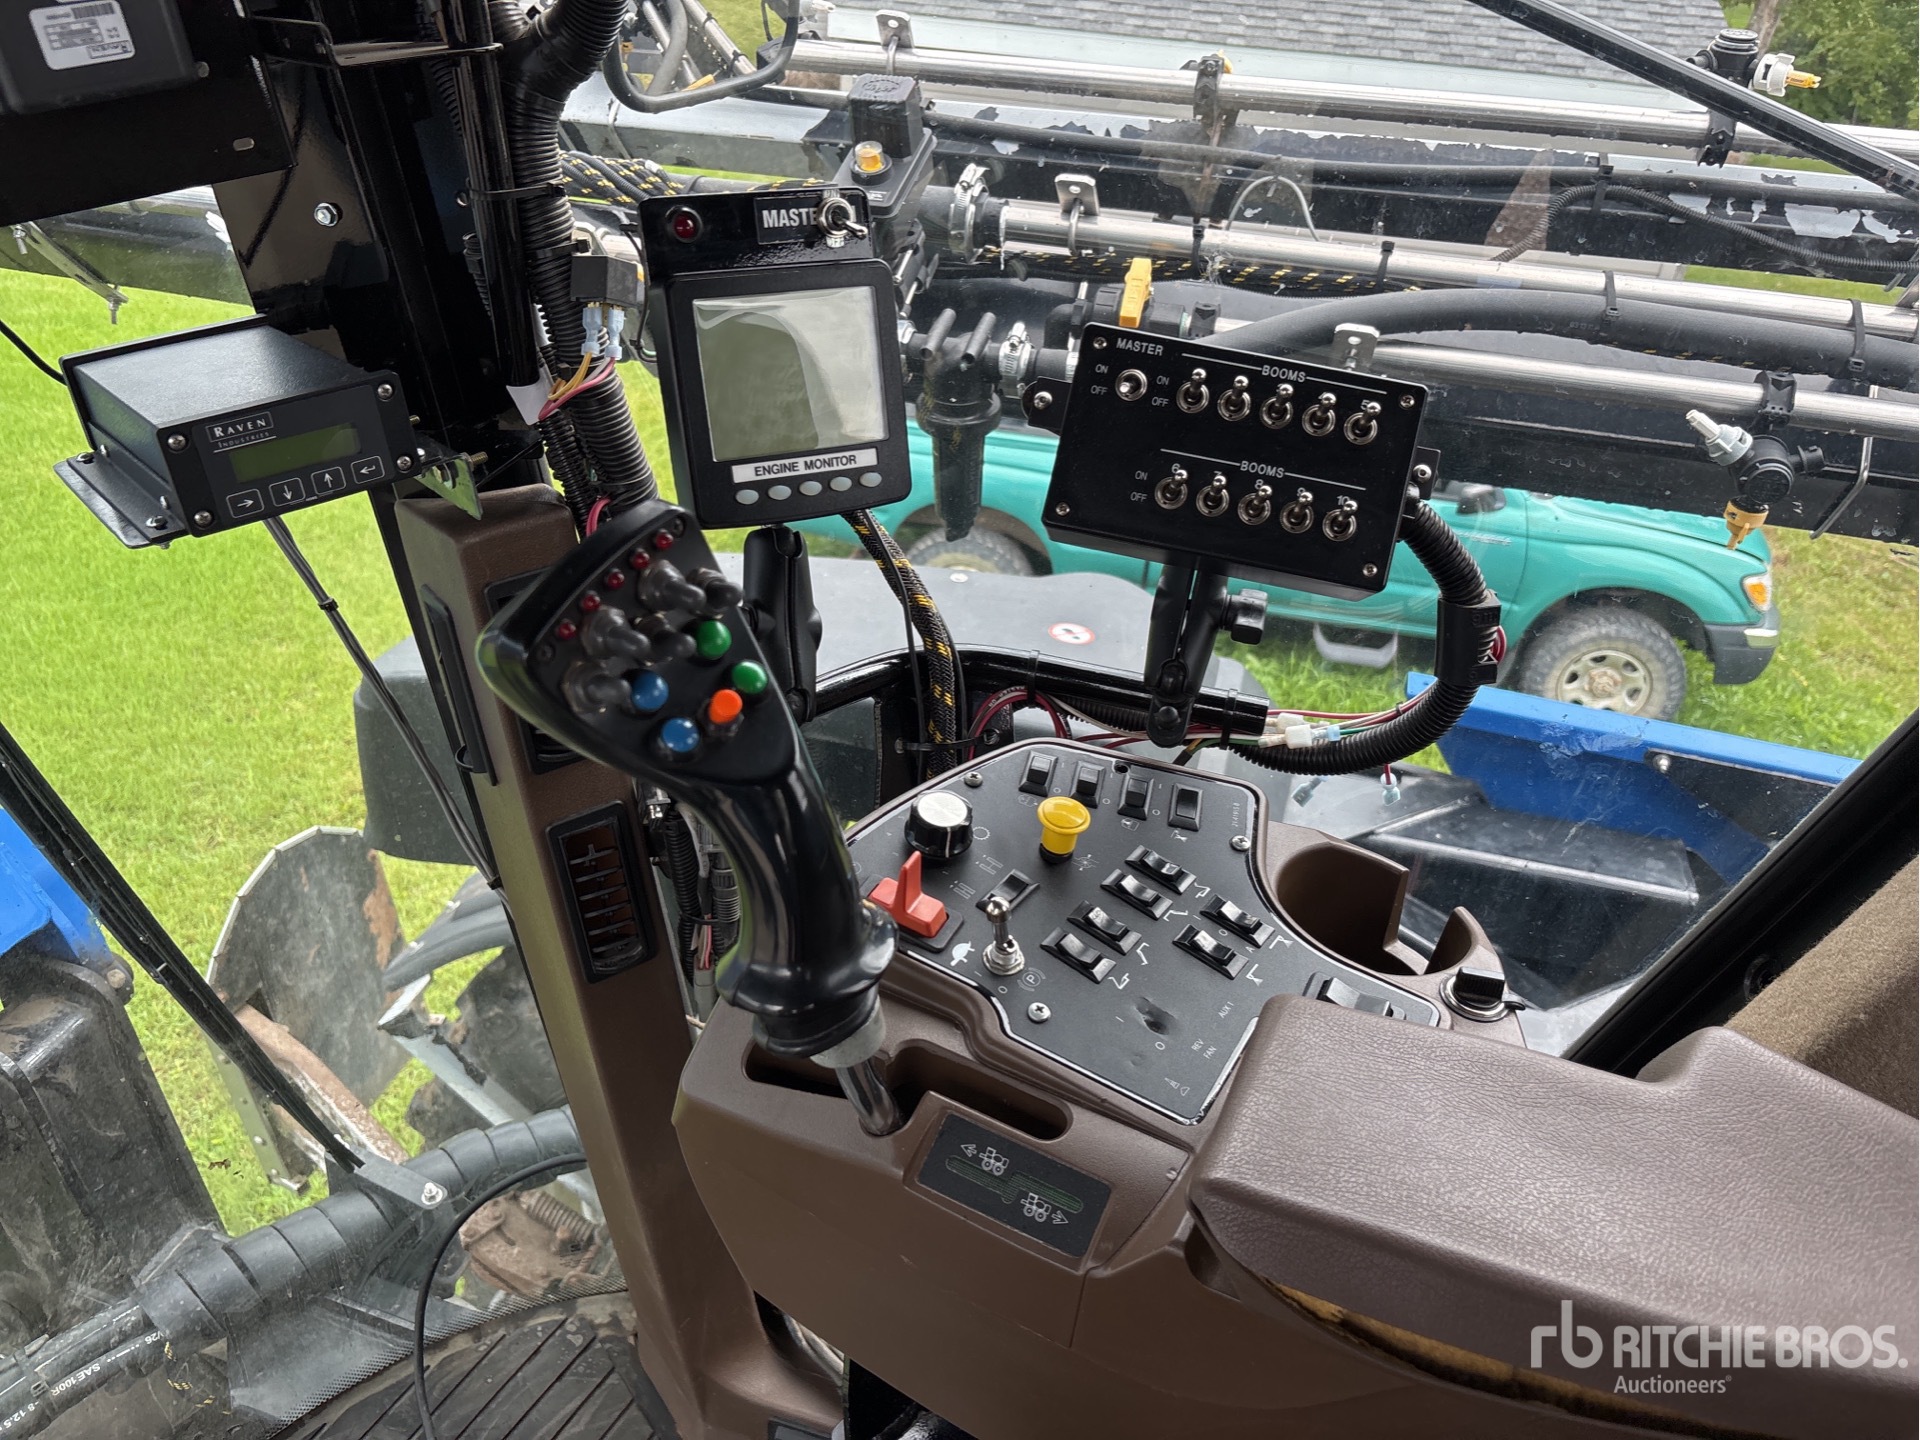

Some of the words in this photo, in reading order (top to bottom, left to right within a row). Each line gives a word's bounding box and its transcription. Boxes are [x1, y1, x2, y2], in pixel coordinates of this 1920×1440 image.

[762, 207, 820, 229] MASTE
[1116, 337, 1164, 357] MASTER
[1095, 363, 1109, 375] ON
[1261, 364, 1307, 383] BOOMS
[1156, 375, 1170, 386] ON
[1090, 384, 1109, 396] OFF
[1151, 396, 1169, 408] OFF
[213, 418, 267, 438] RAVEN
[754, 461, 800, 477] ENGINE
[804, 454, 858, 471] MONITOR
[1240, 460, 1286, 478] BOOMS
[1134, 470, 1149, 481] ON
[1130, 491, 1148, 503] OFF
[1217, 1003, 1232, 1019] AUX
[1191, 1038, 1205, 1052] REV
[1202, 1046, 1217, 1060] FAN
[75, 1362, 101, 1382] SAE
[3, 1409, 27, 1429] 12.5
